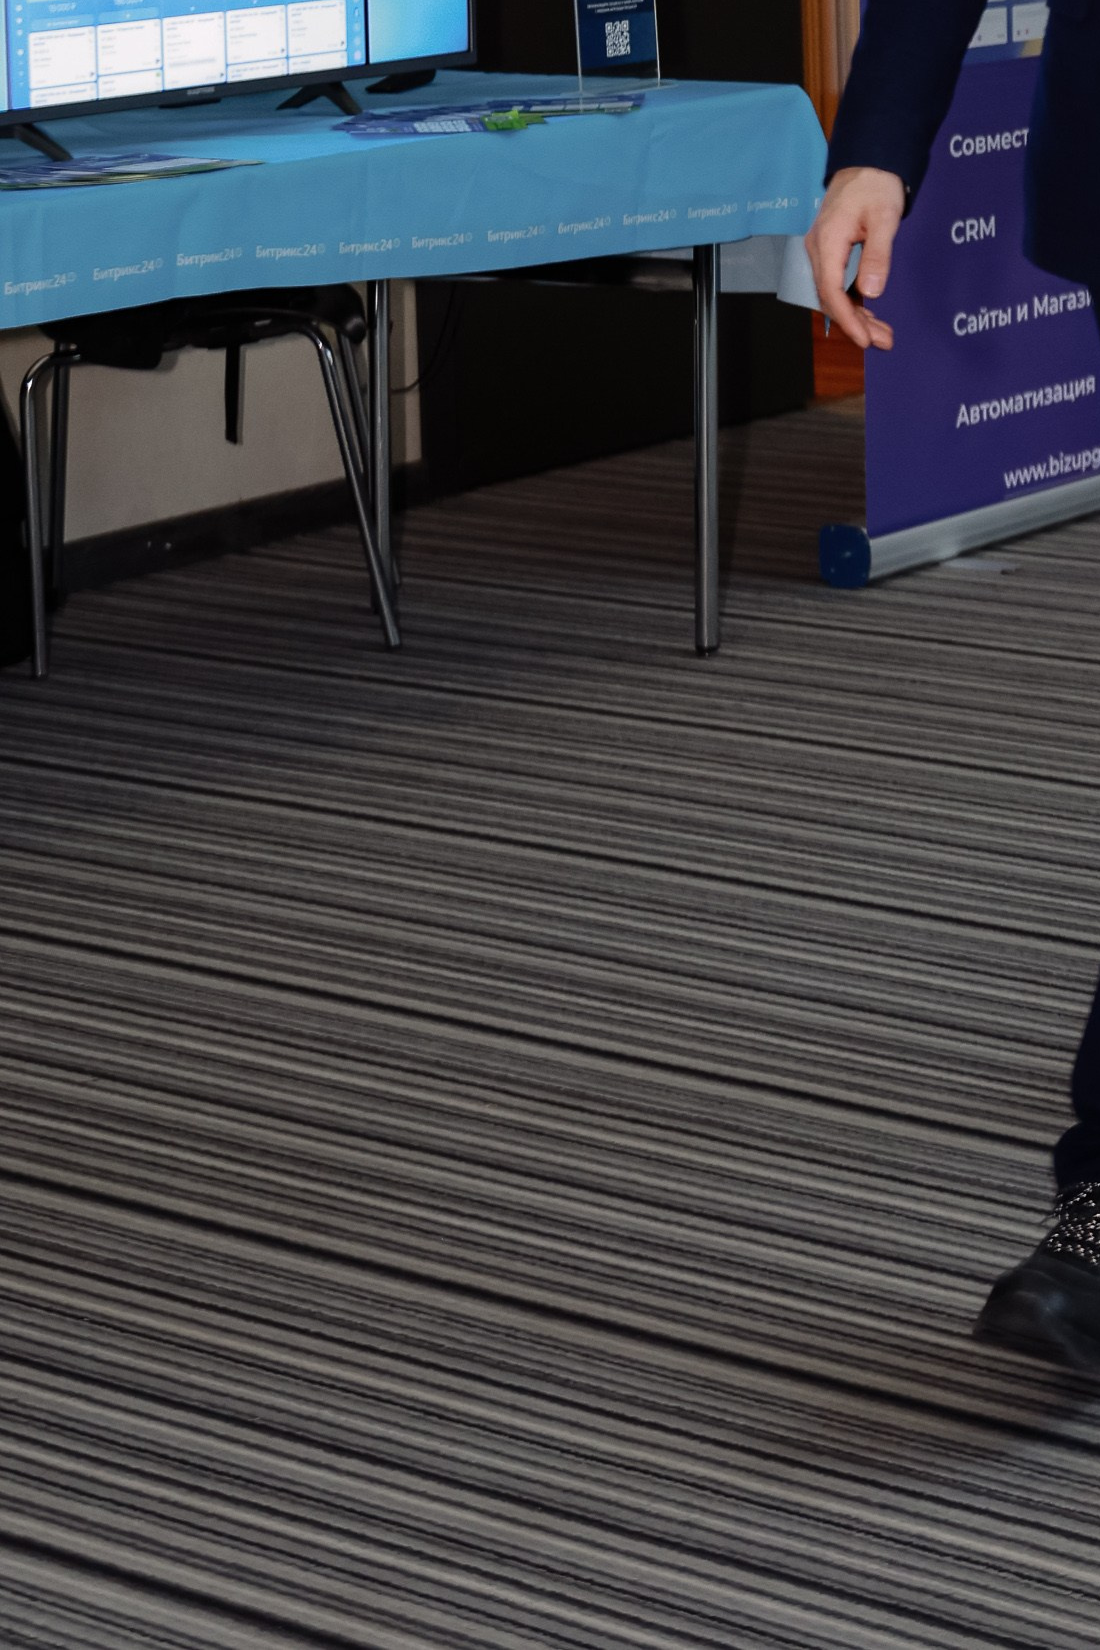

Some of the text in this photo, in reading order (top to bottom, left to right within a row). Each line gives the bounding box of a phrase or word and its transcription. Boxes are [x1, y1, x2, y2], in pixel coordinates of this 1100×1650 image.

[951, 214, 996, 245] CRM
[93, 259, 155, 281] Битрикс24
[255, 244, 317, 260] Битрикс24
[411, 233, 464, 251] Битрикс24
[953, 306, 1012, 336] Сайты
[1017, 303, 1028, 322] и
[955, 375, 1096, 429] Автоматизация
